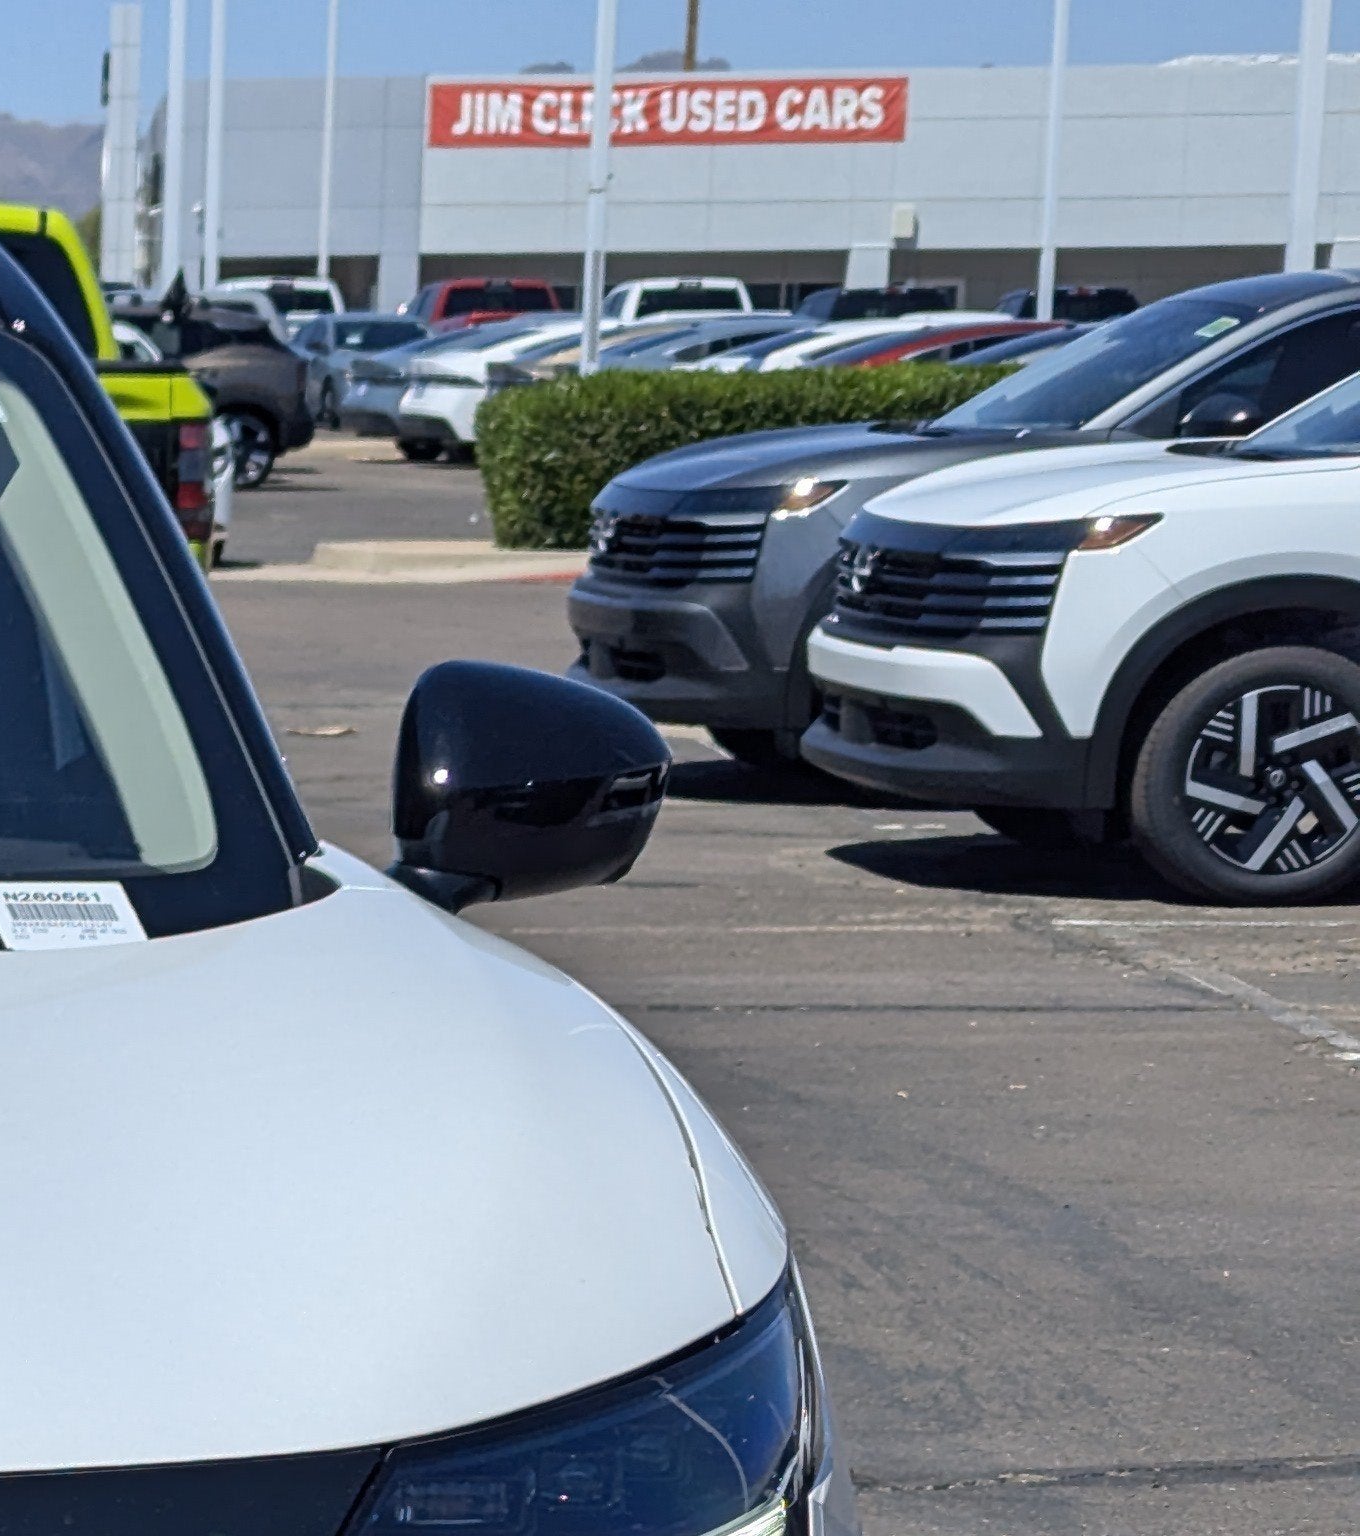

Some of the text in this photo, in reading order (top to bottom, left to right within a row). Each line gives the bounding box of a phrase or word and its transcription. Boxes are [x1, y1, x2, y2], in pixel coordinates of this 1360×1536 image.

[451, 86, 886, 136] JIM CLIK USED CARS
